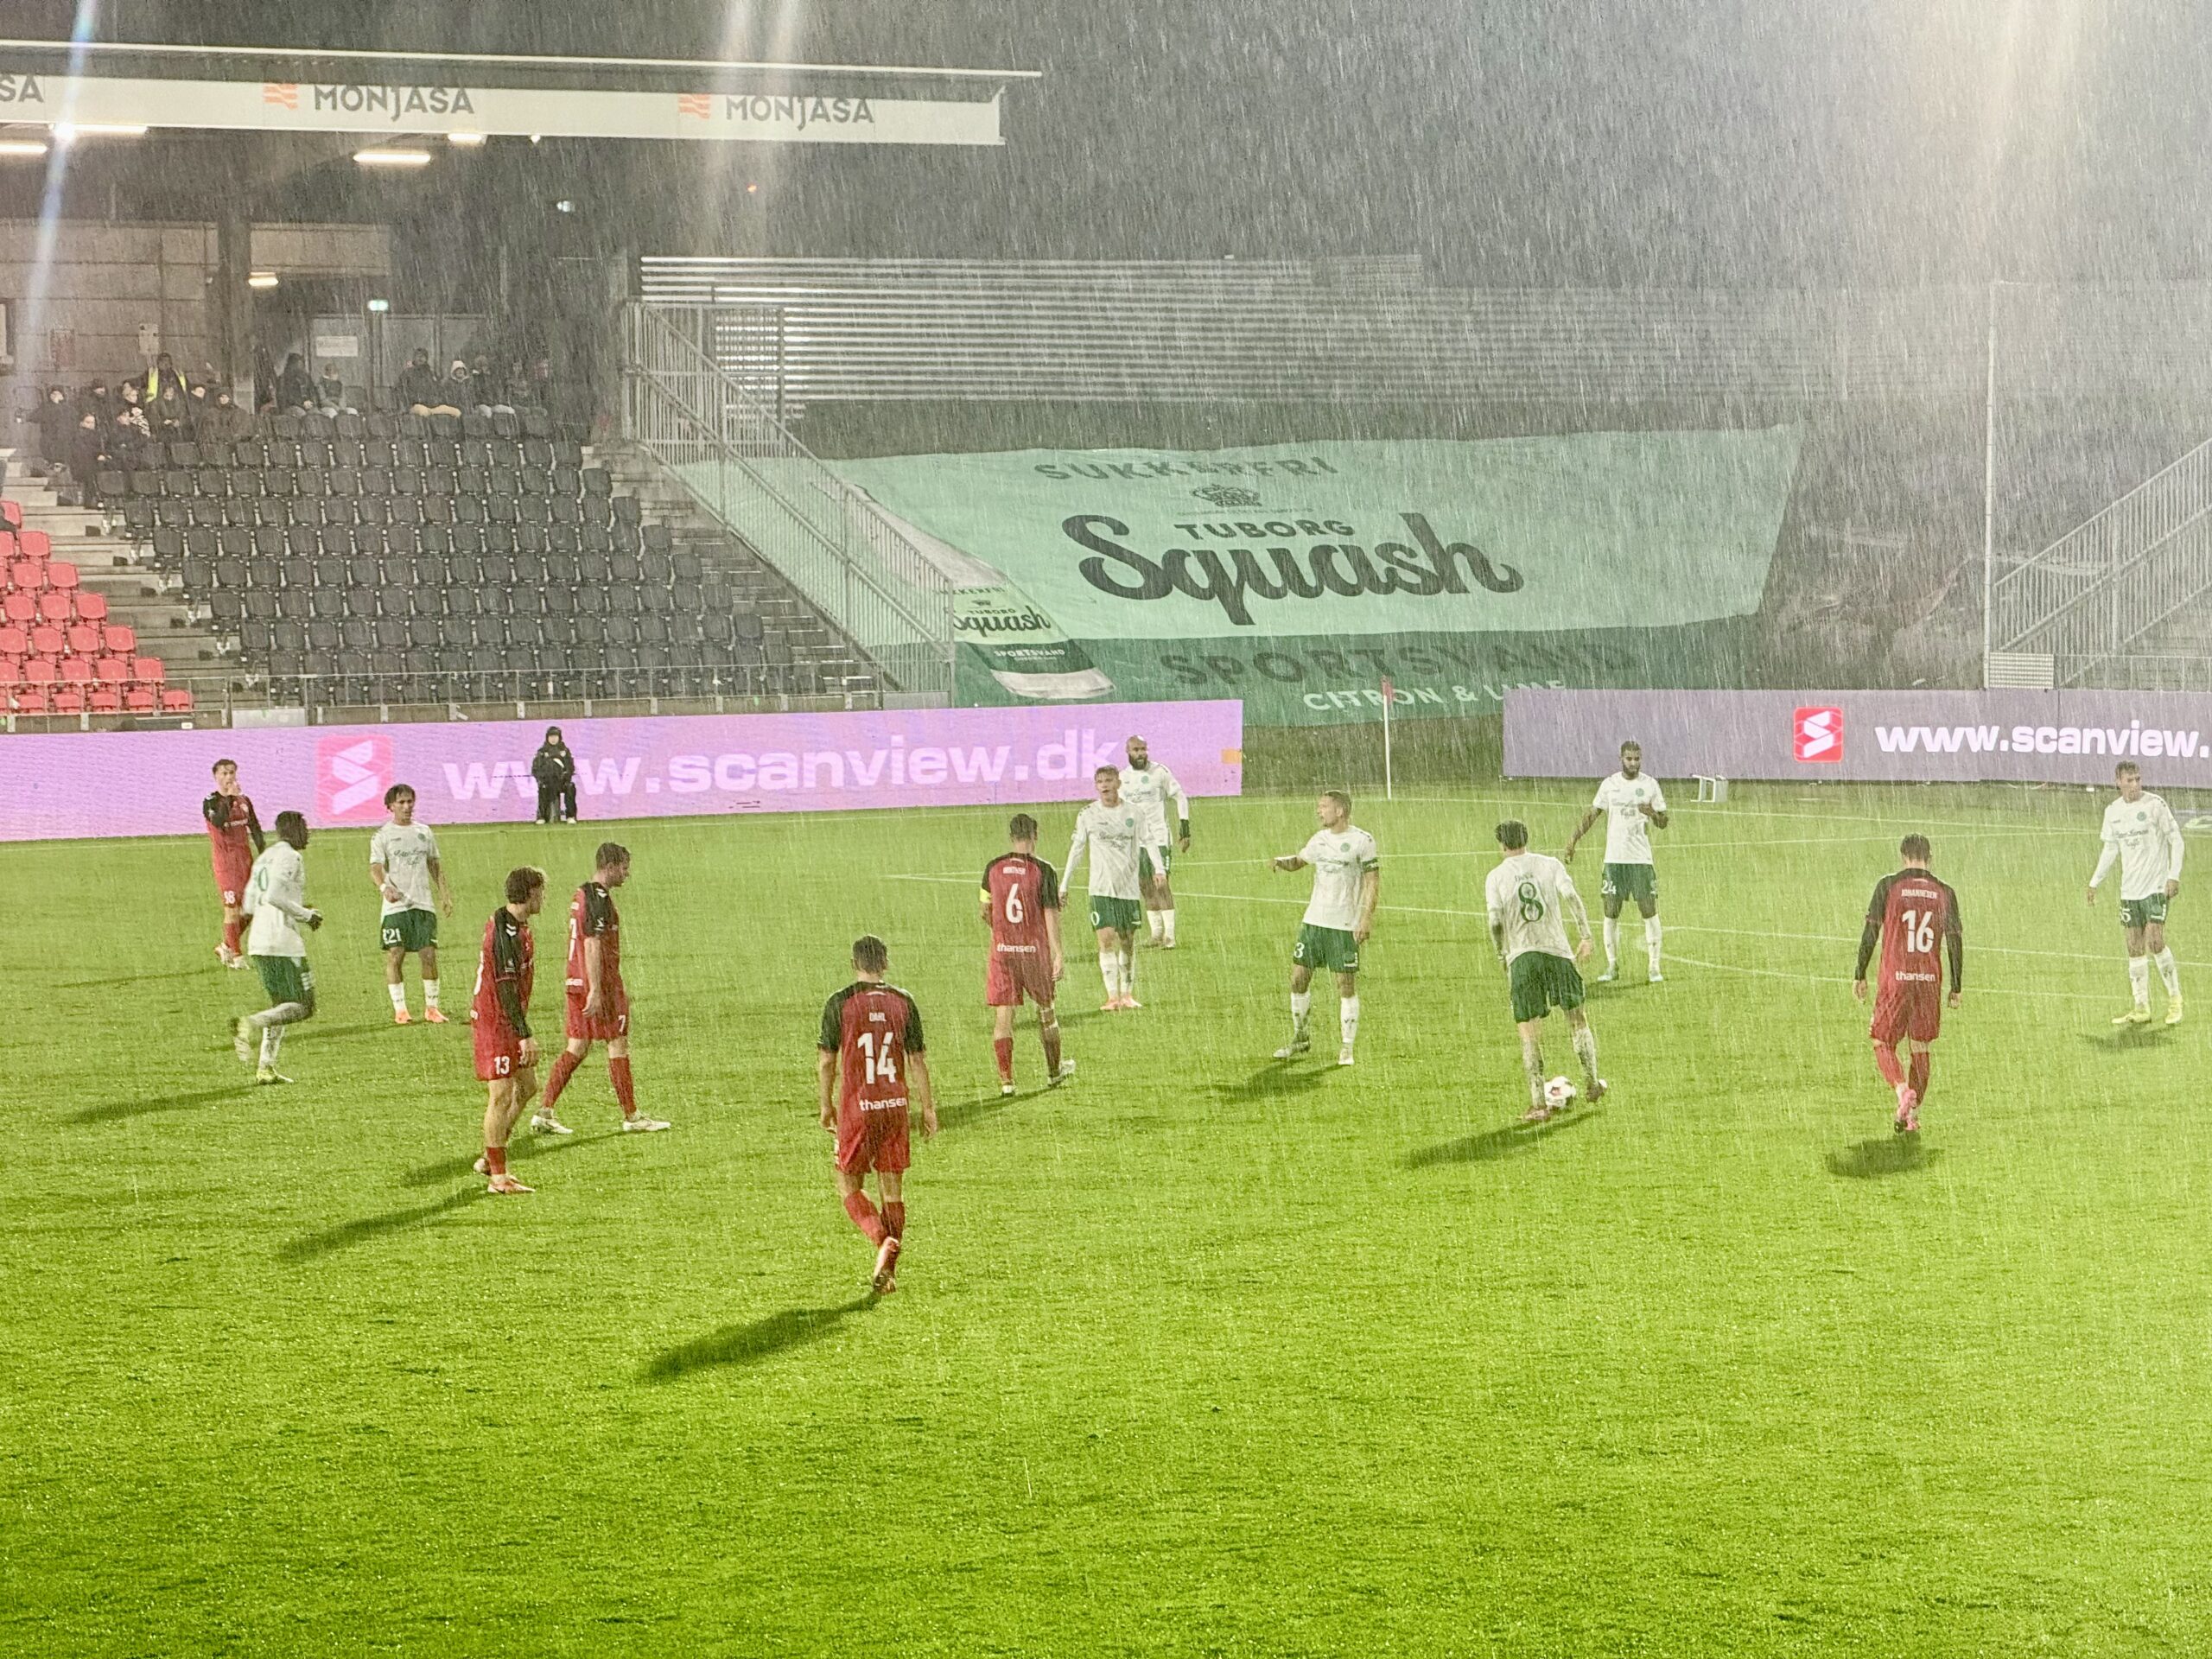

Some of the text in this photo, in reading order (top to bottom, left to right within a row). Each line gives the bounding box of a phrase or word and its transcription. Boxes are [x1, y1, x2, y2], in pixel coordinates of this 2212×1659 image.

[314, 86, 475, 122] MONJASA
[726, 95, 875, 131] MONJASA
[1174, 518, 1355, 540] TUBORG
[1062, 512, 1524, 626] Squash
[994, 649, 1065, 658] SPORTSVAND
[1303, 686, 1444, 711] CITRON
[1452, 684, 1478, 702] &
[1006, 883, 1024, 924] 6
[1518, 881, 1545, 922] 8
[1902, 910, 1934, 953] 16
[996, 943, 1037, 954] thansen
[1895, 970, 1936, 982] thansen
[493, 1056, 511, 1075] 13
[857, 1032, 896, 1085] 14
[859, 1097, 907, 1112] thansen
